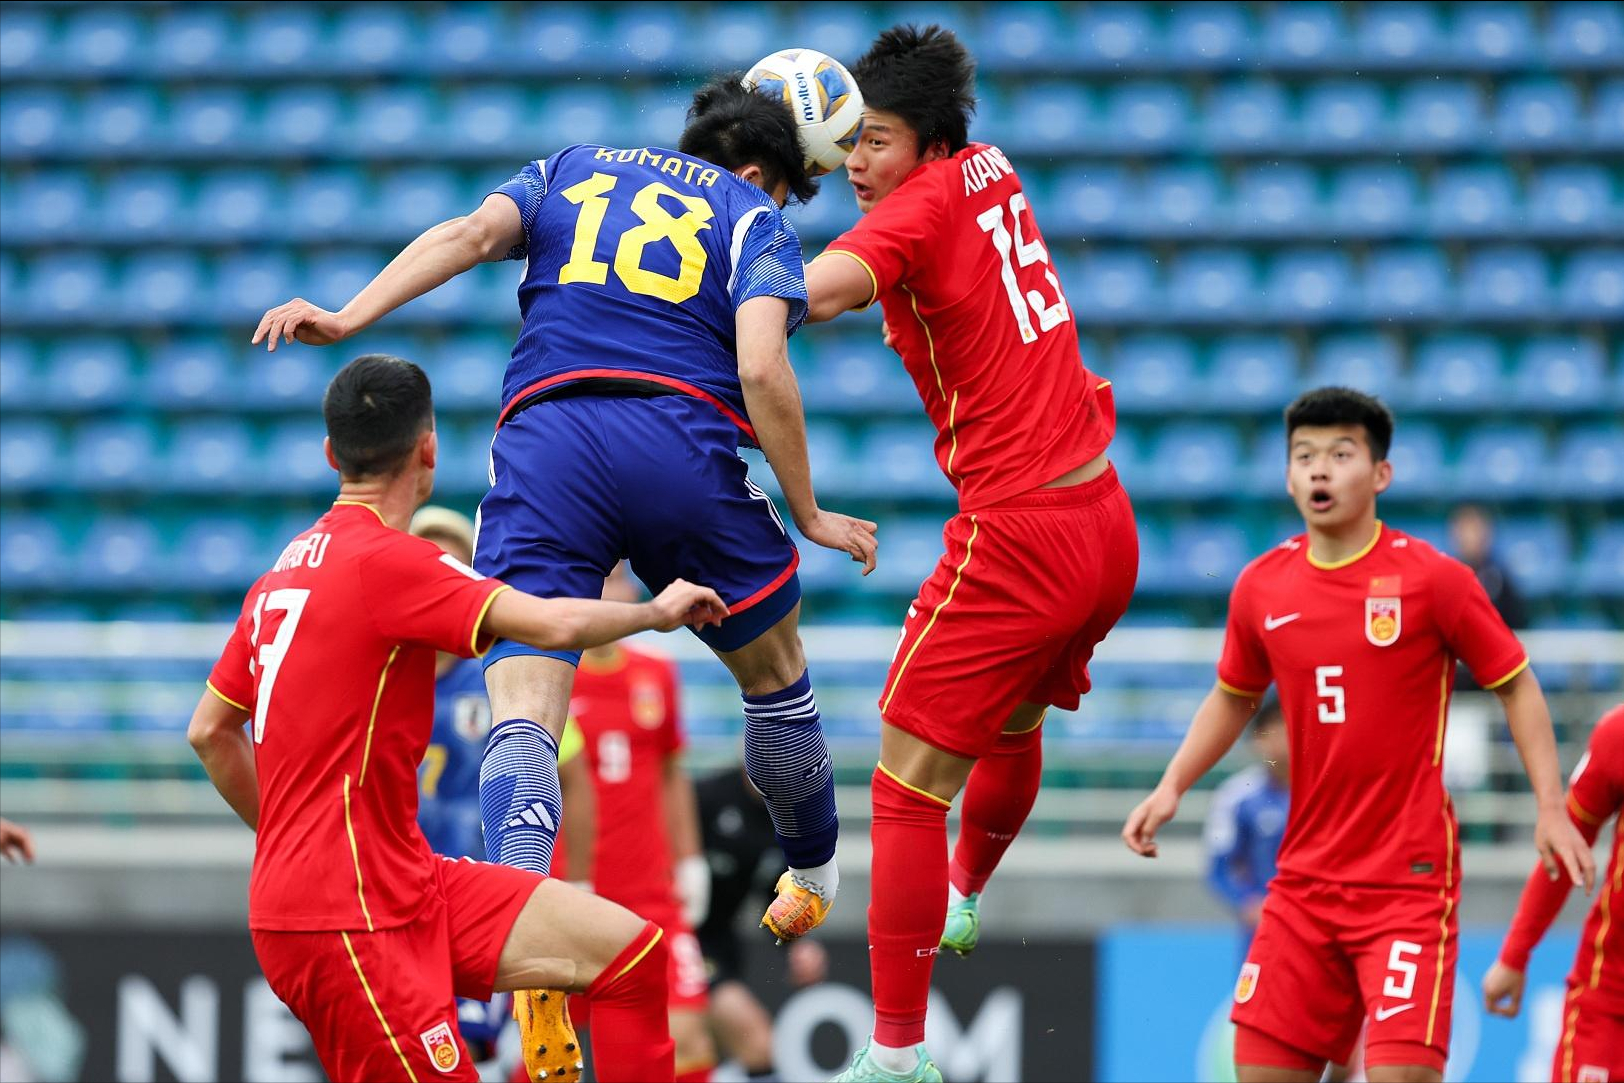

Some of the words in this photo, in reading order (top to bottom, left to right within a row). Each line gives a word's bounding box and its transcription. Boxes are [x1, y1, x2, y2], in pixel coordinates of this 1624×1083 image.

[795, 72, 814, 121] molten
[961, 145, 1014, 197] XIAN
[558, 171, 716, 305] 18
[976, 192, 1071, 345] 15
[1315, 665, 1346, 724] 5
[1382, 939, 1423, 1000] 5
